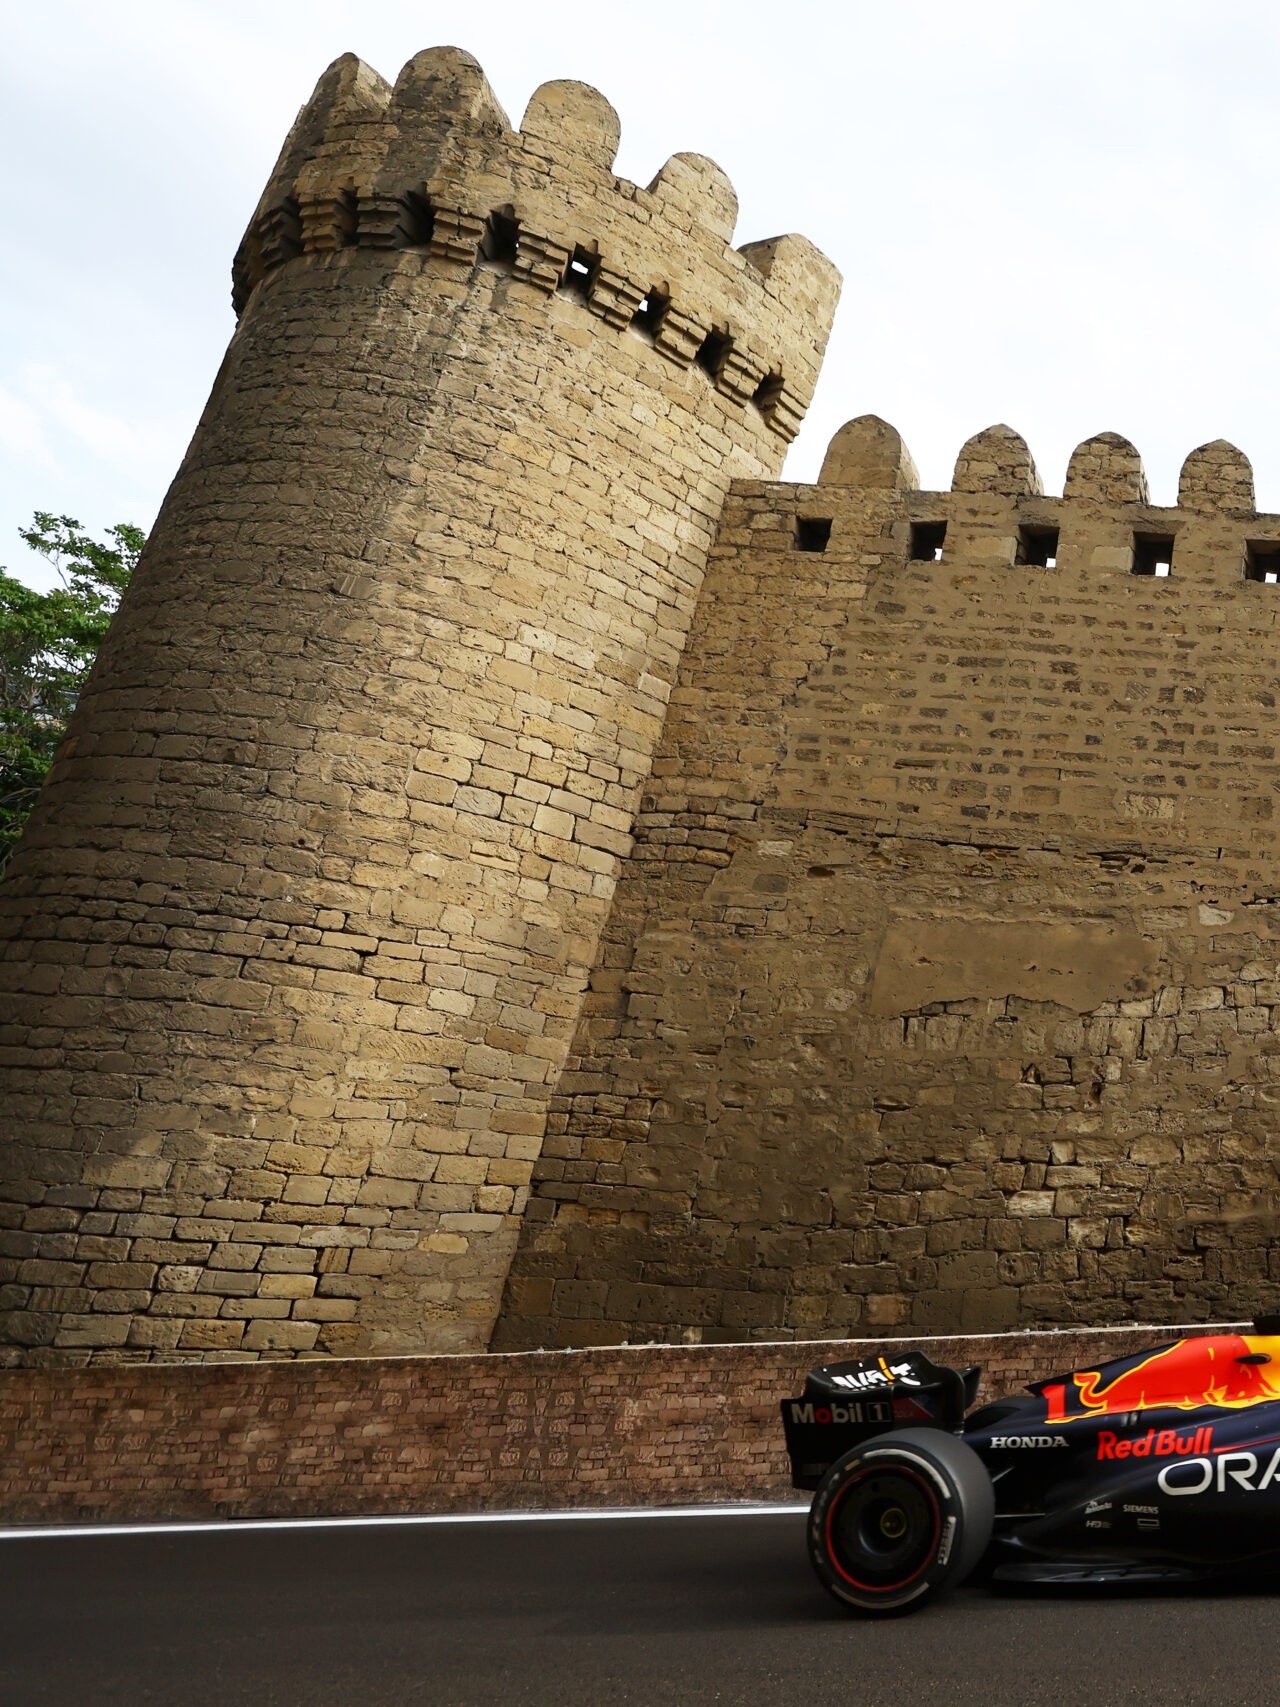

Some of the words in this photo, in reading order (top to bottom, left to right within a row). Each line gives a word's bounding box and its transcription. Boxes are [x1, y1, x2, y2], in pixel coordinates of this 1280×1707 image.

[791, 1403, 864, 1424] Mobil
[990, 1436, 1069, 1449] HONDA
[1122, 1504, 1159, 1515] SIEMENS
